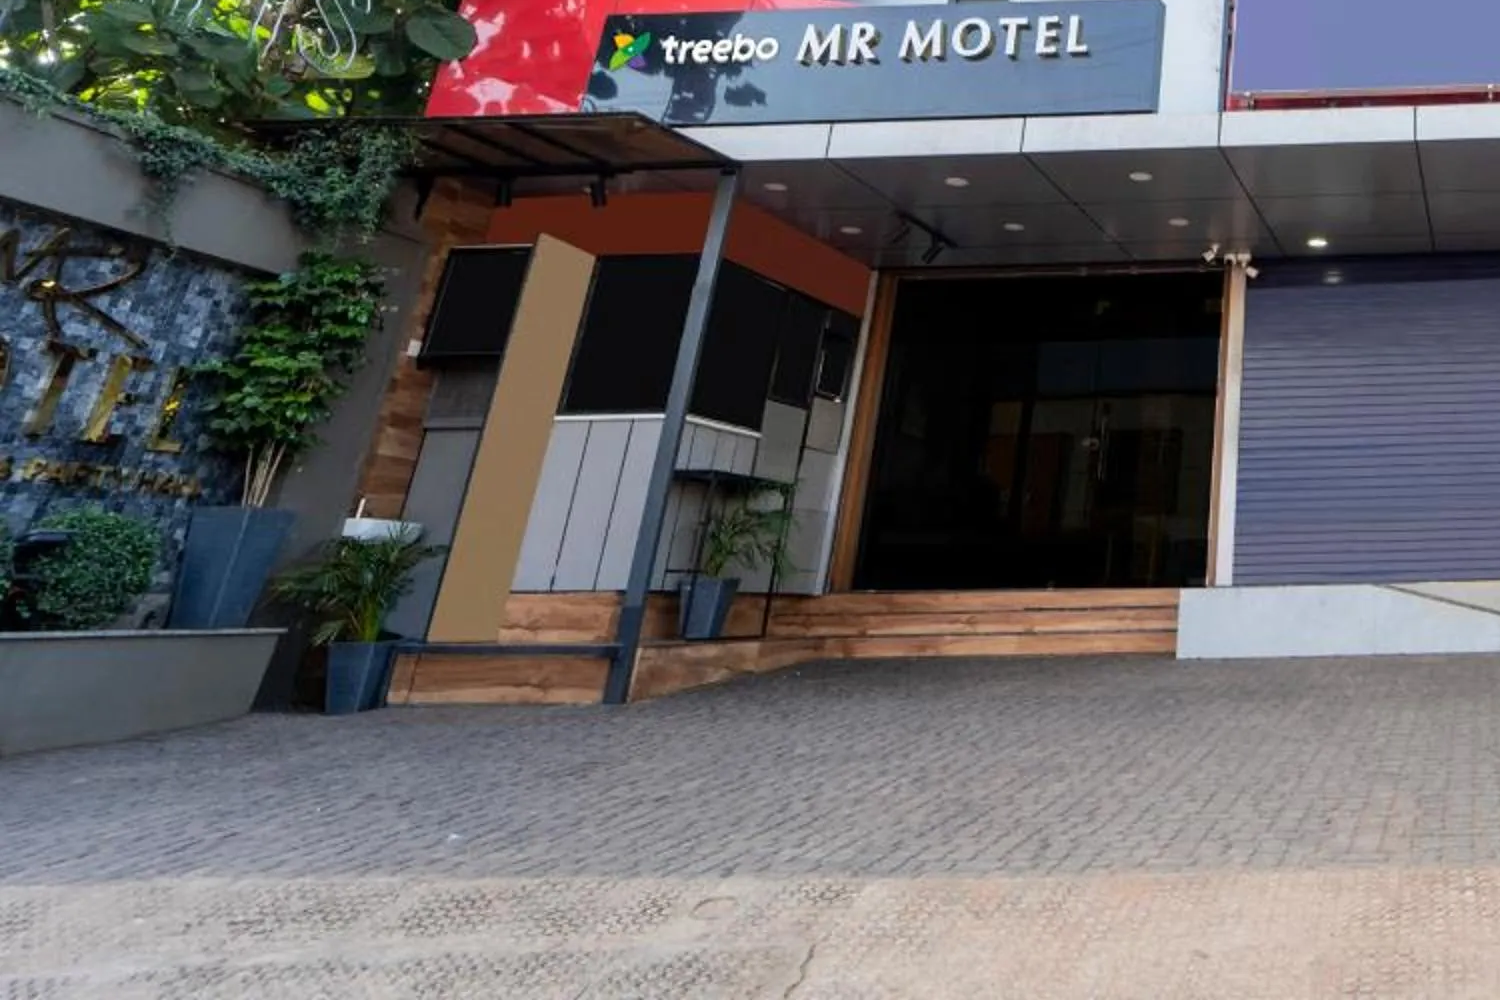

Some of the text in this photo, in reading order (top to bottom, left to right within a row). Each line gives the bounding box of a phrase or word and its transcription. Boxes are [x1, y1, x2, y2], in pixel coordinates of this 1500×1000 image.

[659, 13, 1090, 66] treebo MR MOTEL
[0, 338, 192, 454] TEL
